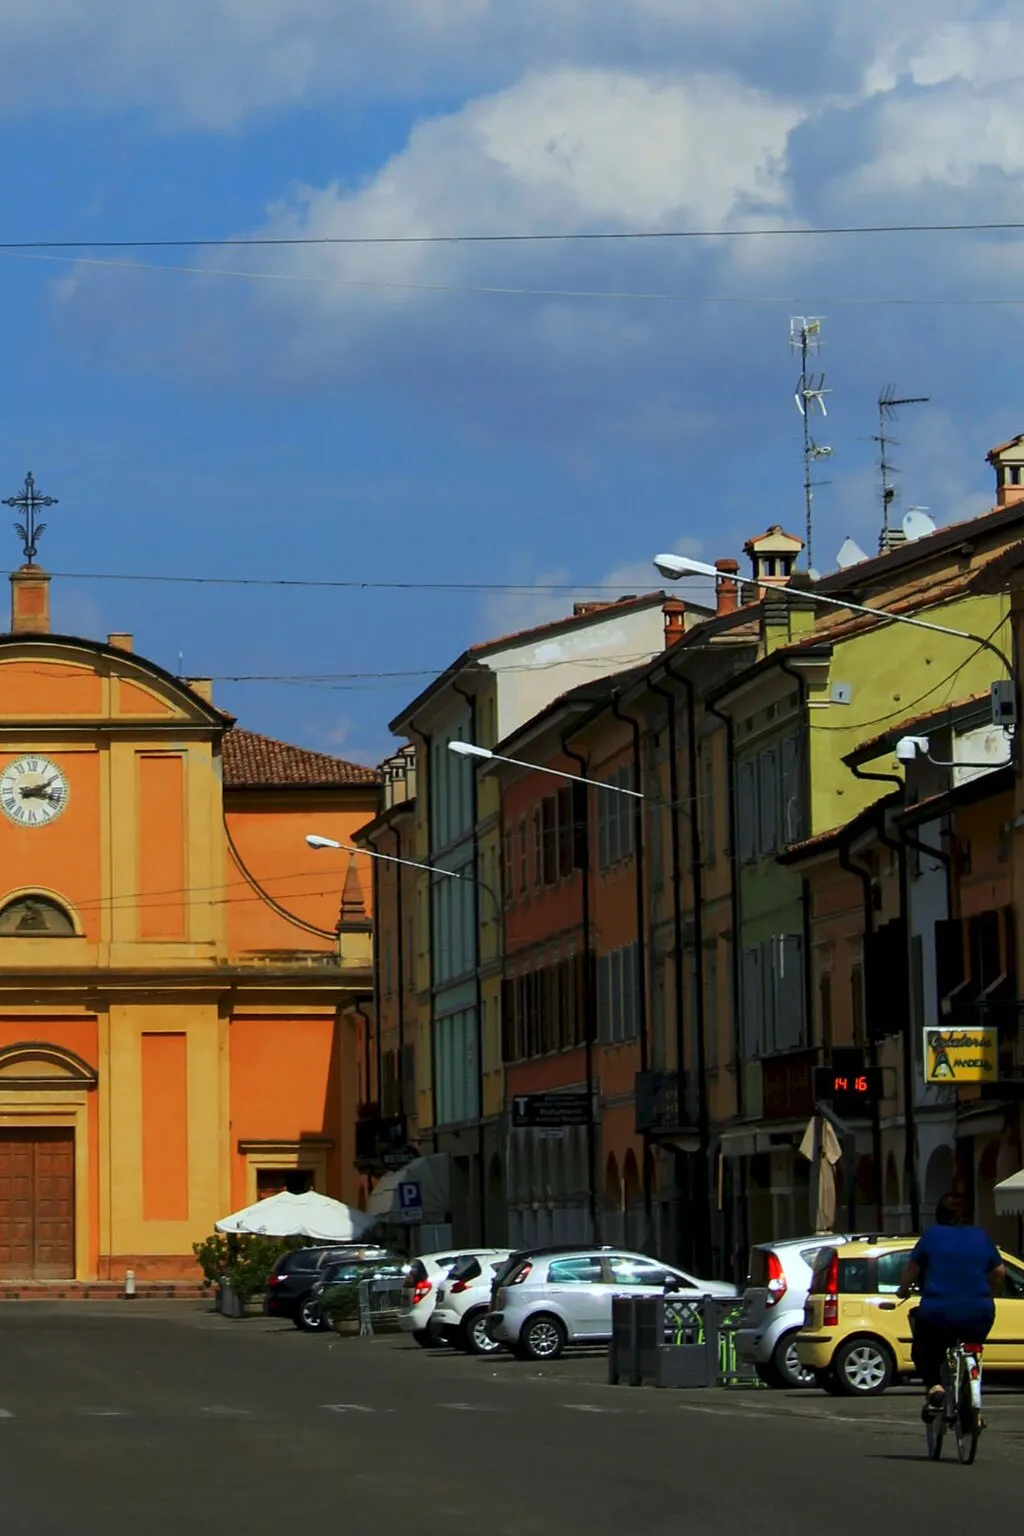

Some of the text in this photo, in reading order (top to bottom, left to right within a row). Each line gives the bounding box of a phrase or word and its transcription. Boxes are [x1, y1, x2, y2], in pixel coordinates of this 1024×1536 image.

[834, 1076, 867, 1090] 14 16
[514, 1096, 530, 1115] T
[402, 1184, 418, 1205] P
